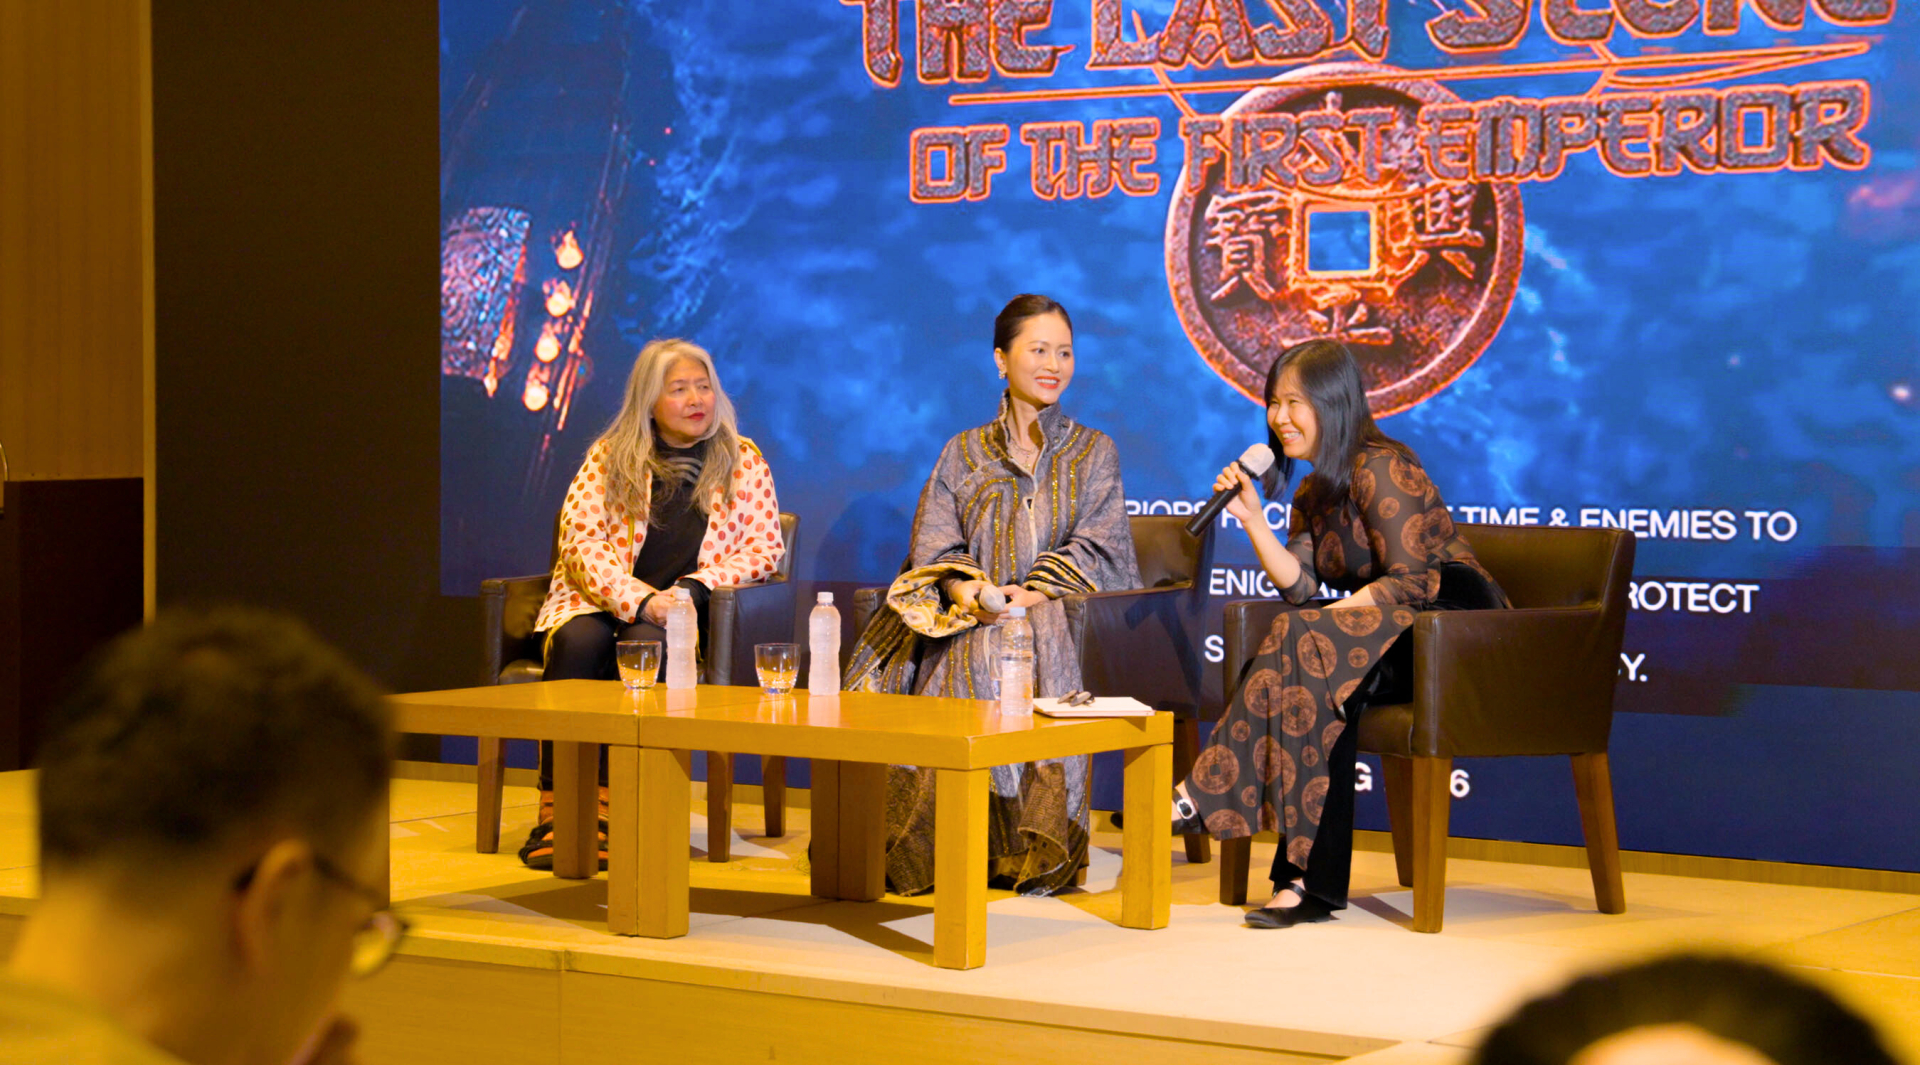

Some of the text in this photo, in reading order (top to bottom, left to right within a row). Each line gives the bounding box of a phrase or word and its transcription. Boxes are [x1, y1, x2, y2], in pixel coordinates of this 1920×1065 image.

[910, 79, 1871, 203] OF THE FIRST EMPEROR
[1580, 507, 1737, 541] ENEMIES
[1745, 510, 1798, 542] TO
[1629, 581, 1760, 613] ROTECT
